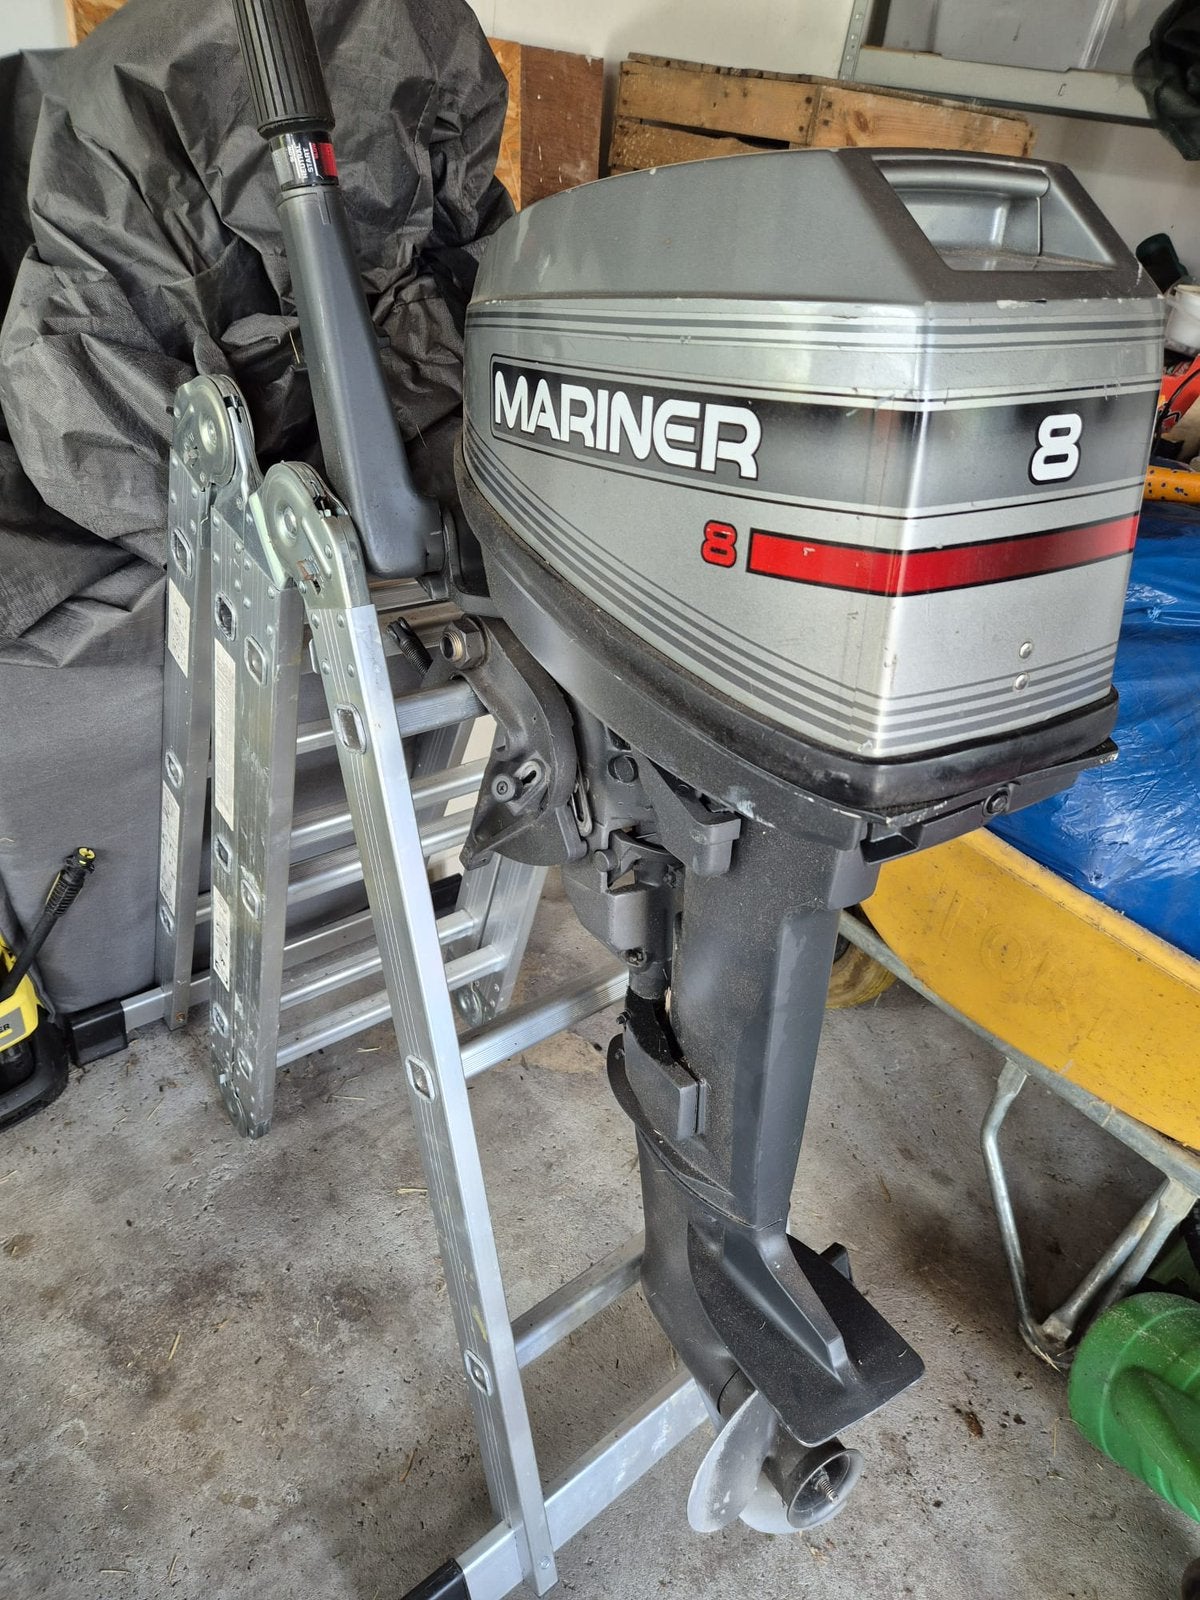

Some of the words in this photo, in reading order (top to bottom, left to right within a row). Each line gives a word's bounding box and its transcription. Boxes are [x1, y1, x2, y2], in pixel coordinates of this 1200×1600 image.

[302, 147, 314, 173] START
[495, 370, 762, 479] MARINER
[1029, 412, 1083, 485] 8
[702, 519, 737, 568] 8
